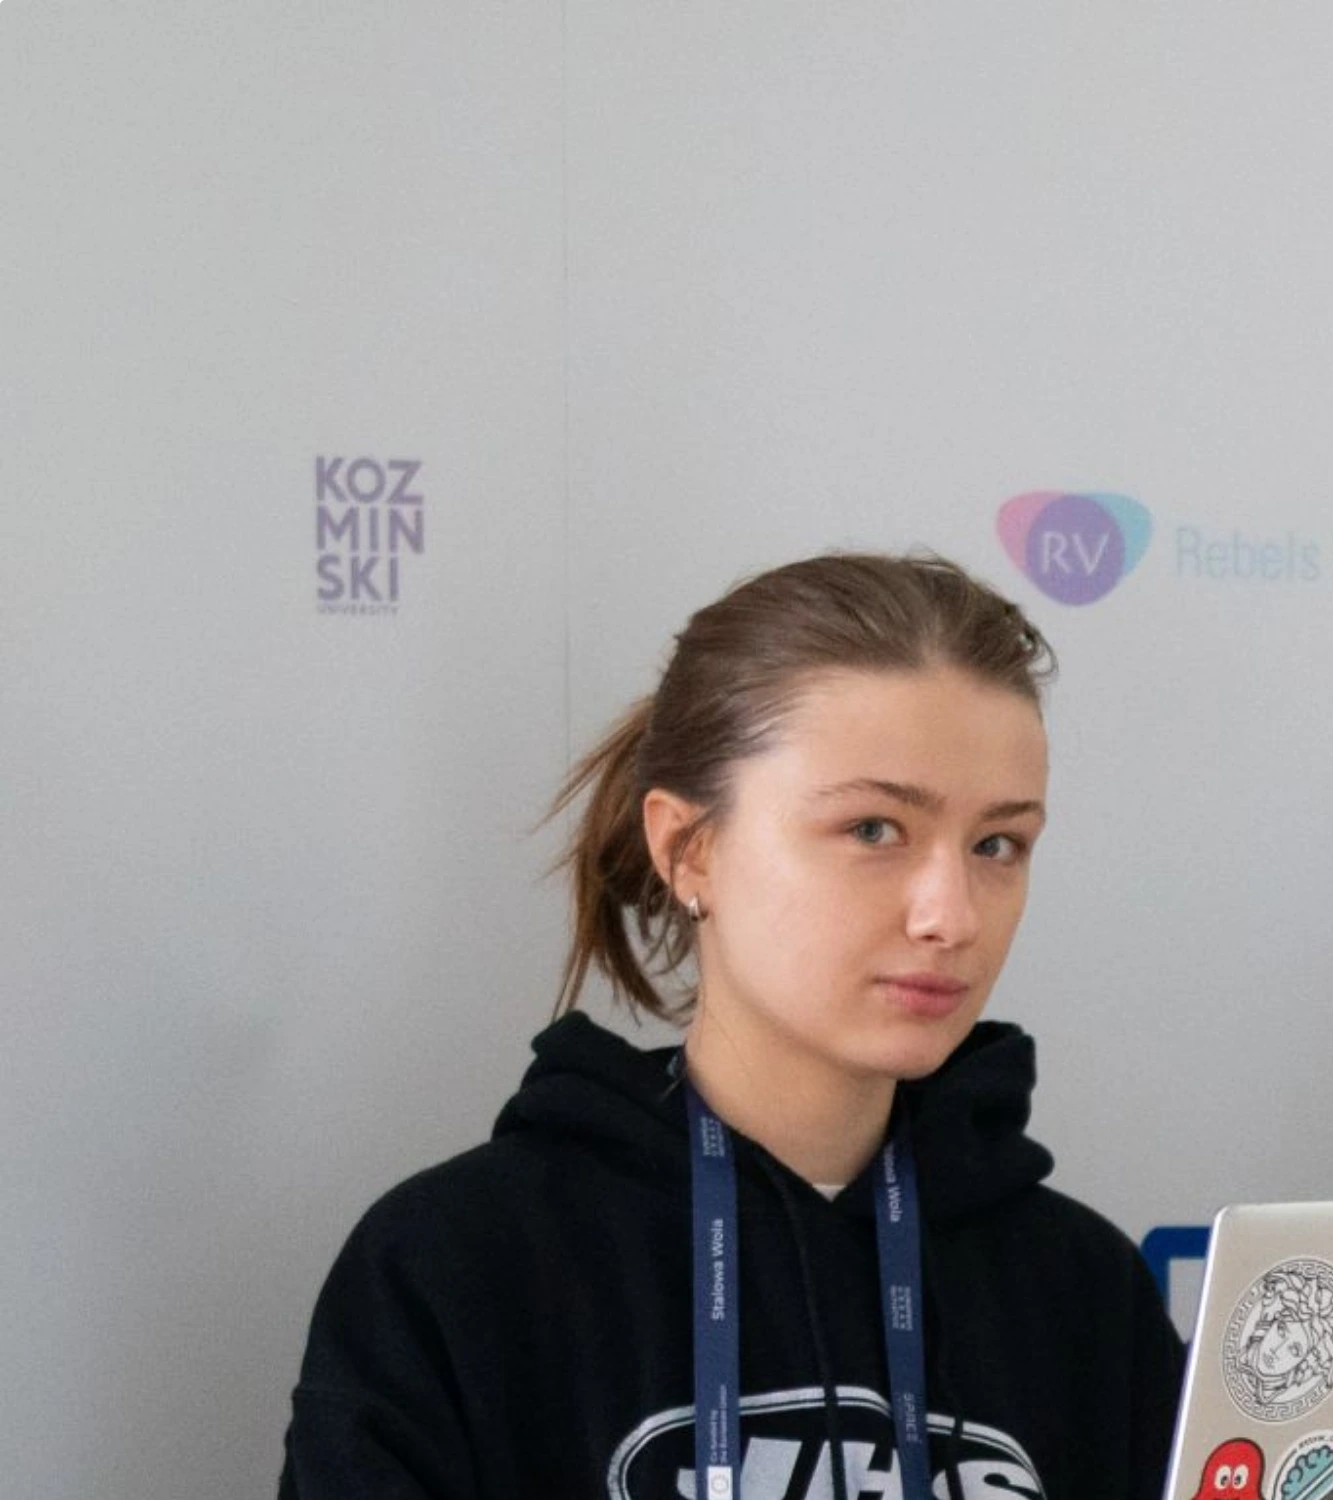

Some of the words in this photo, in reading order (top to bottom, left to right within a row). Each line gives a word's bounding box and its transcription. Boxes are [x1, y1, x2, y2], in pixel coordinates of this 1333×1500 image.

[315, 456, 424, 506] KOZ
[316, 506, 425, 555] MIN
[1041, 530, 1112, 577] RV
[1174, 526, 1320, 584] Rebels
[316, 554, 399, 602] SKI
[711, 1218, 725, 1257] Wola
[711, 1261, 726, 1321] Stalowa
